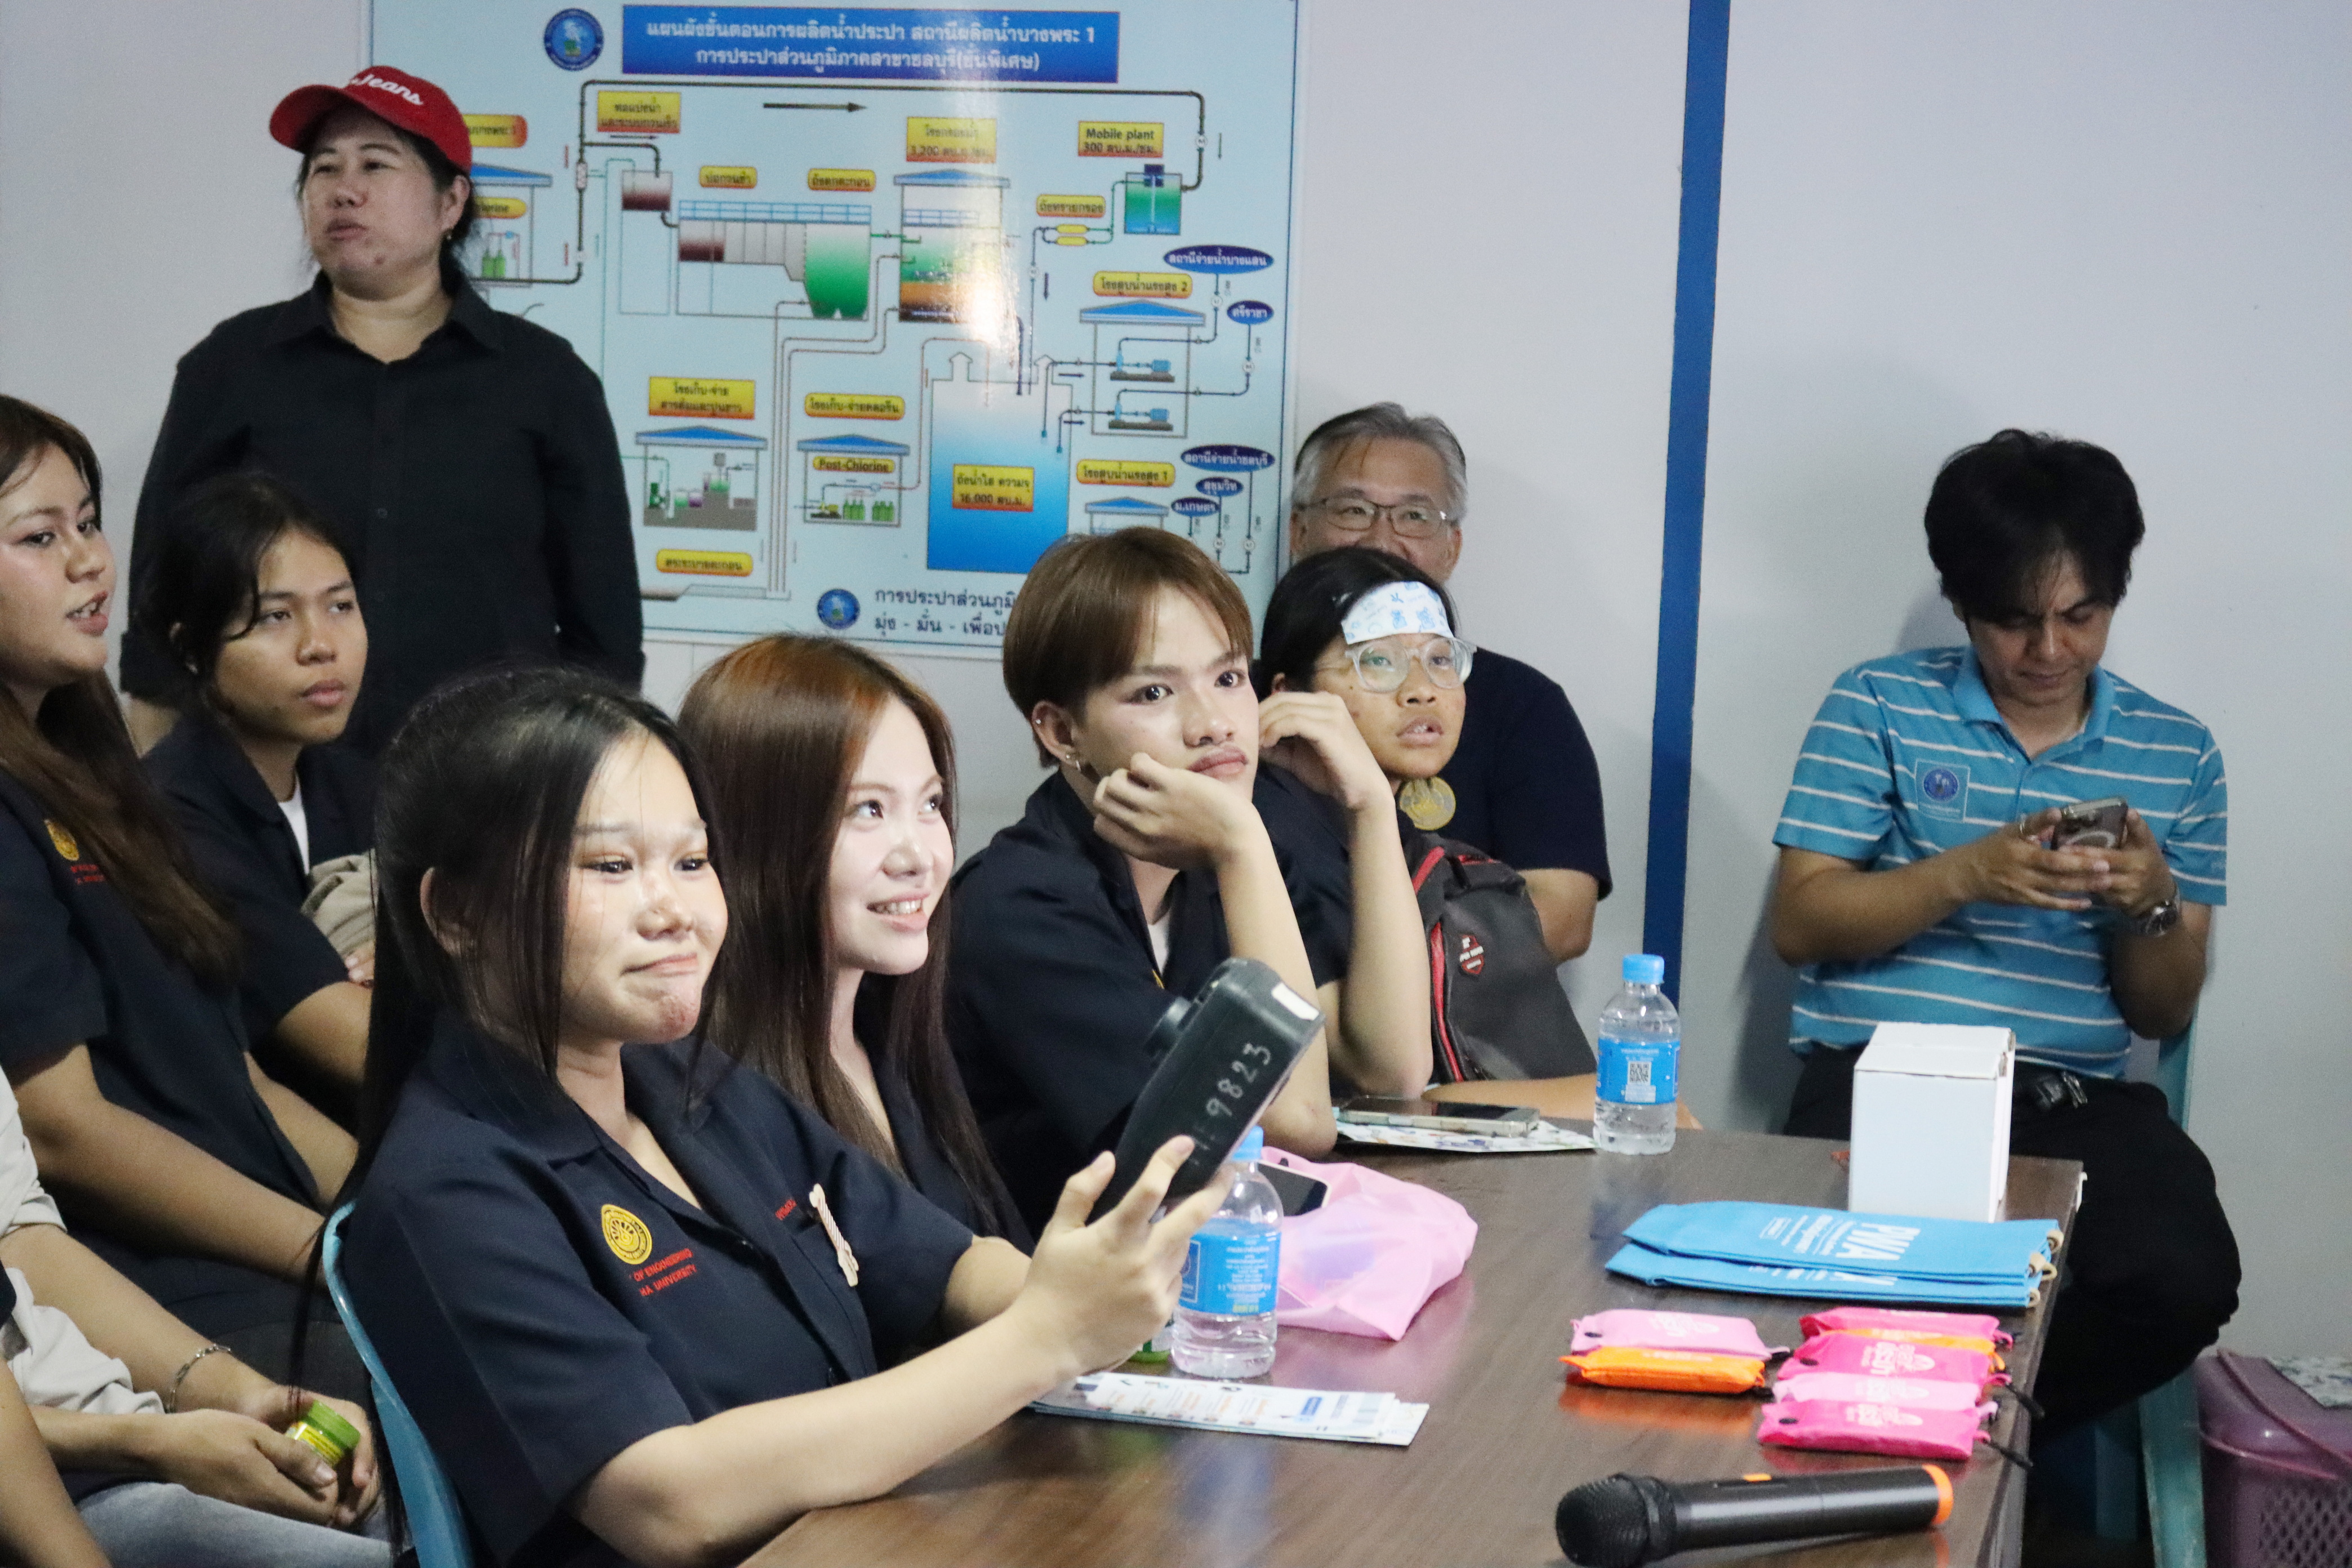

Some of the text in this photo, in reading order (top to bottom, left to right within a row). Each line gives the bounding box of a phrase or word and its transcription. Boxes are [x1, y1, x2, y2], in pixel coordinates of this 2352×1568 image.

[1087, 27, 1094, 43] 1
[1086, 128, 1154, 141] Mobile plant
[875, 612, 896, 636] มุ่ง
[916, 609, 942, 633] มั่น
[1836, 1222, 1921, 1260] PWA
